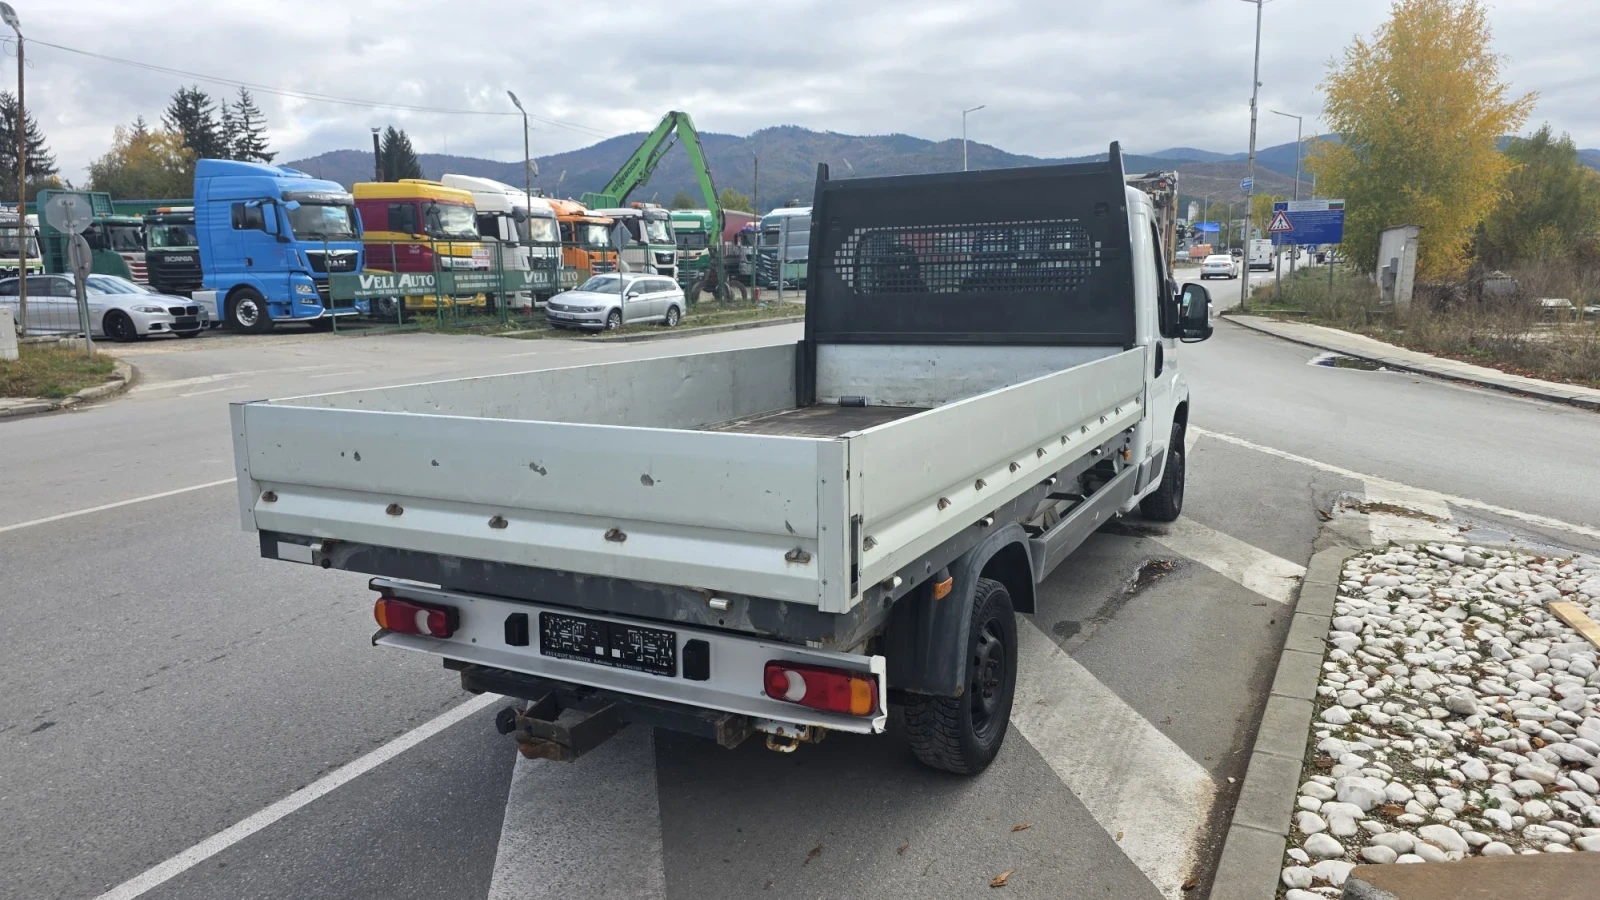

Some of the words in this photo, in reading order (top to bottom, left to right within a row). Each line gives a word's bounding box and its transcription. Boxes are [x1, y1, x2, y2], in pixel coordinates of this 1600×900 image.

[358, 274, 395, 289] VELI
[398, 273, 435, 288] AUTO
[523, 271, 548, 283] VELI
